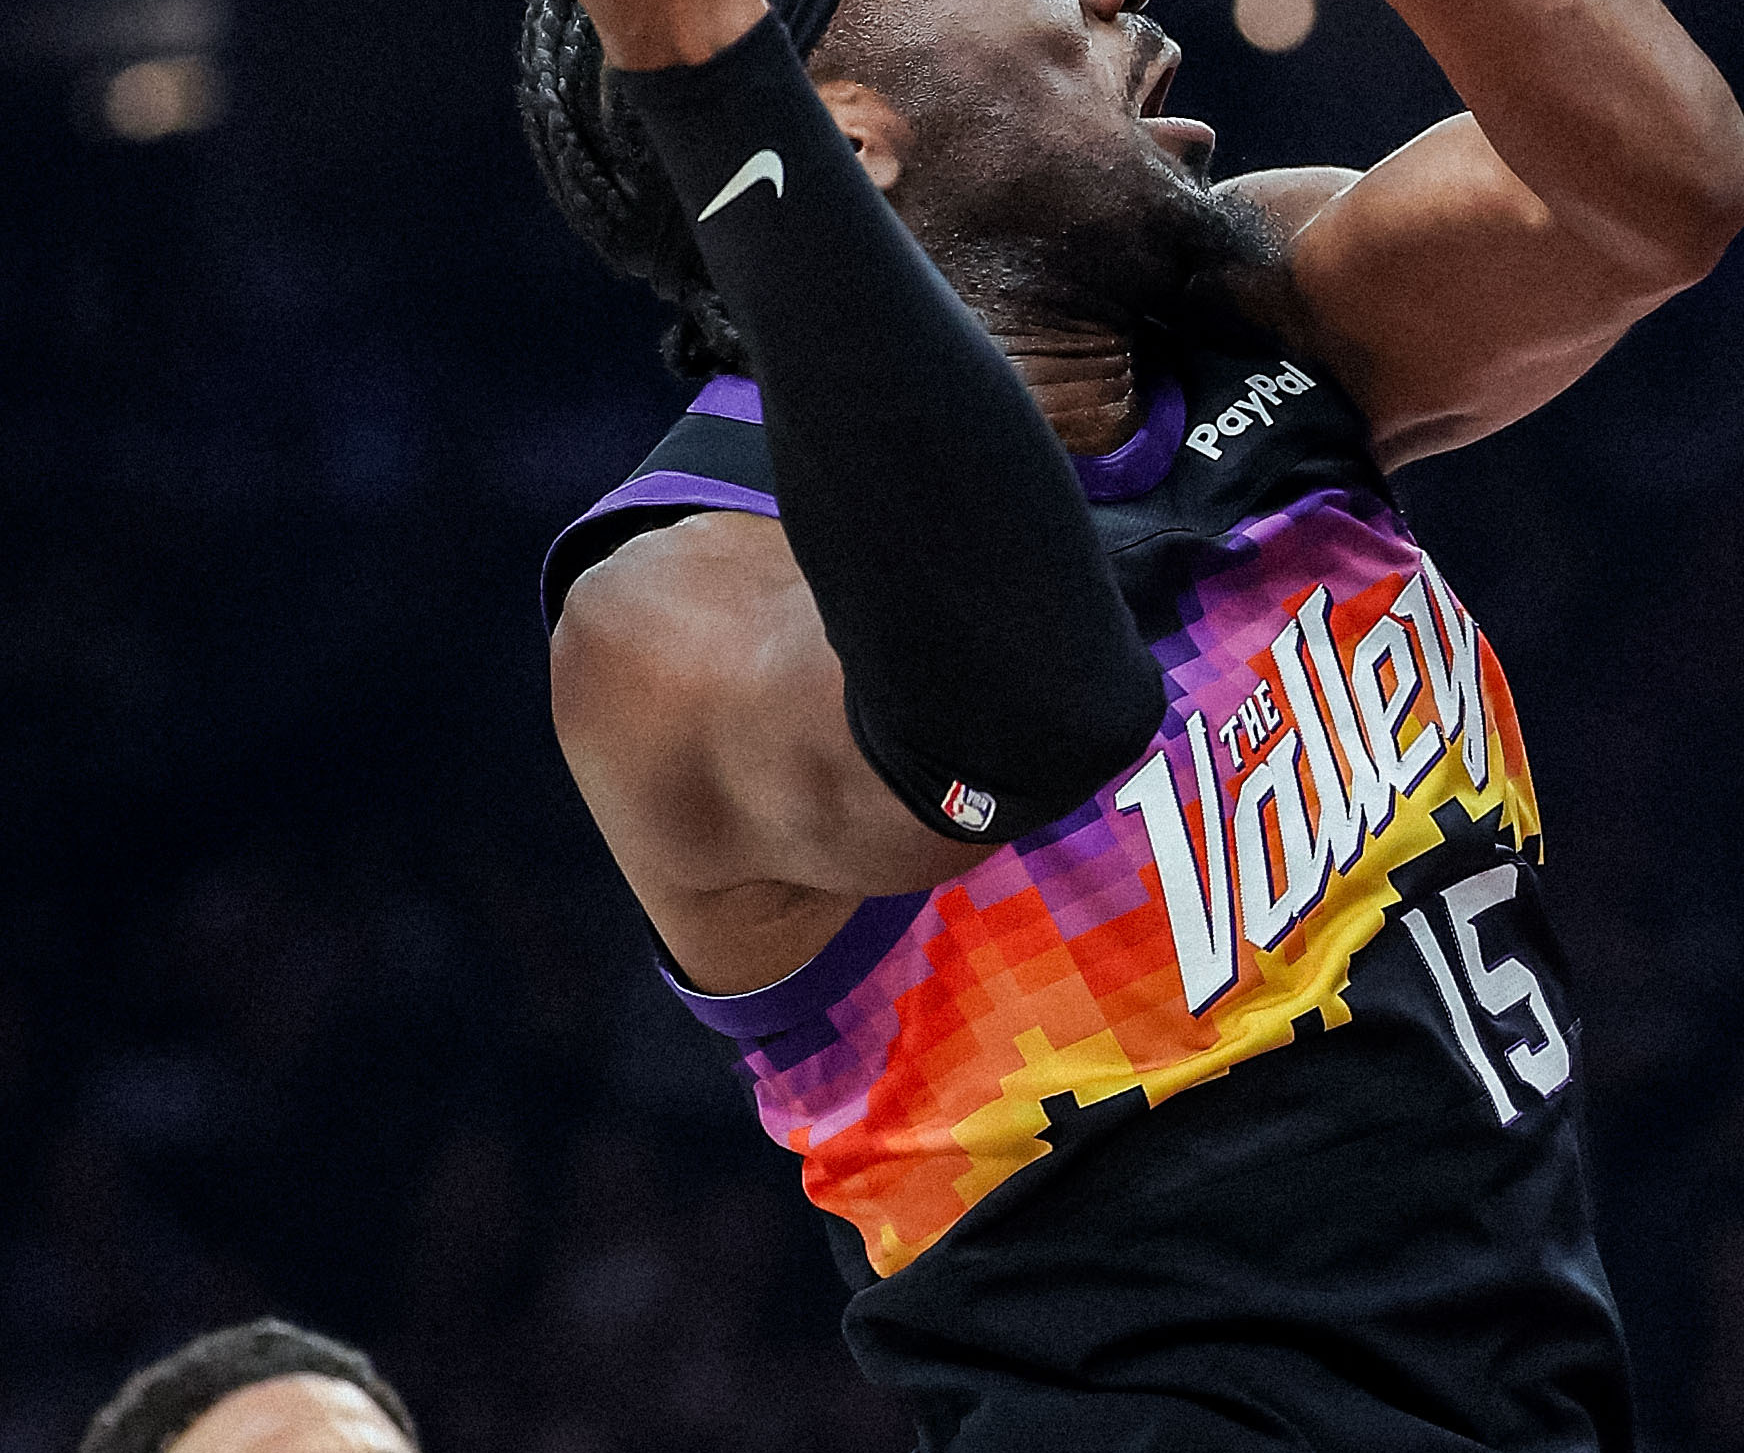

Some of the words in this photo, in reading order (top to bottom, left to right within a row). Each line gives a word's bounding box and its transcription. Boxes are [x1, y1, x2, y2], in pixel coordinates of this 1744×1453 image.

[1186, 361, 1316, 460] PayPal
[1115, 549, 1482, 1016] Valley
[1219, 679, 1281, 772] THE
[1401, 863, 1571, 1126] 15
